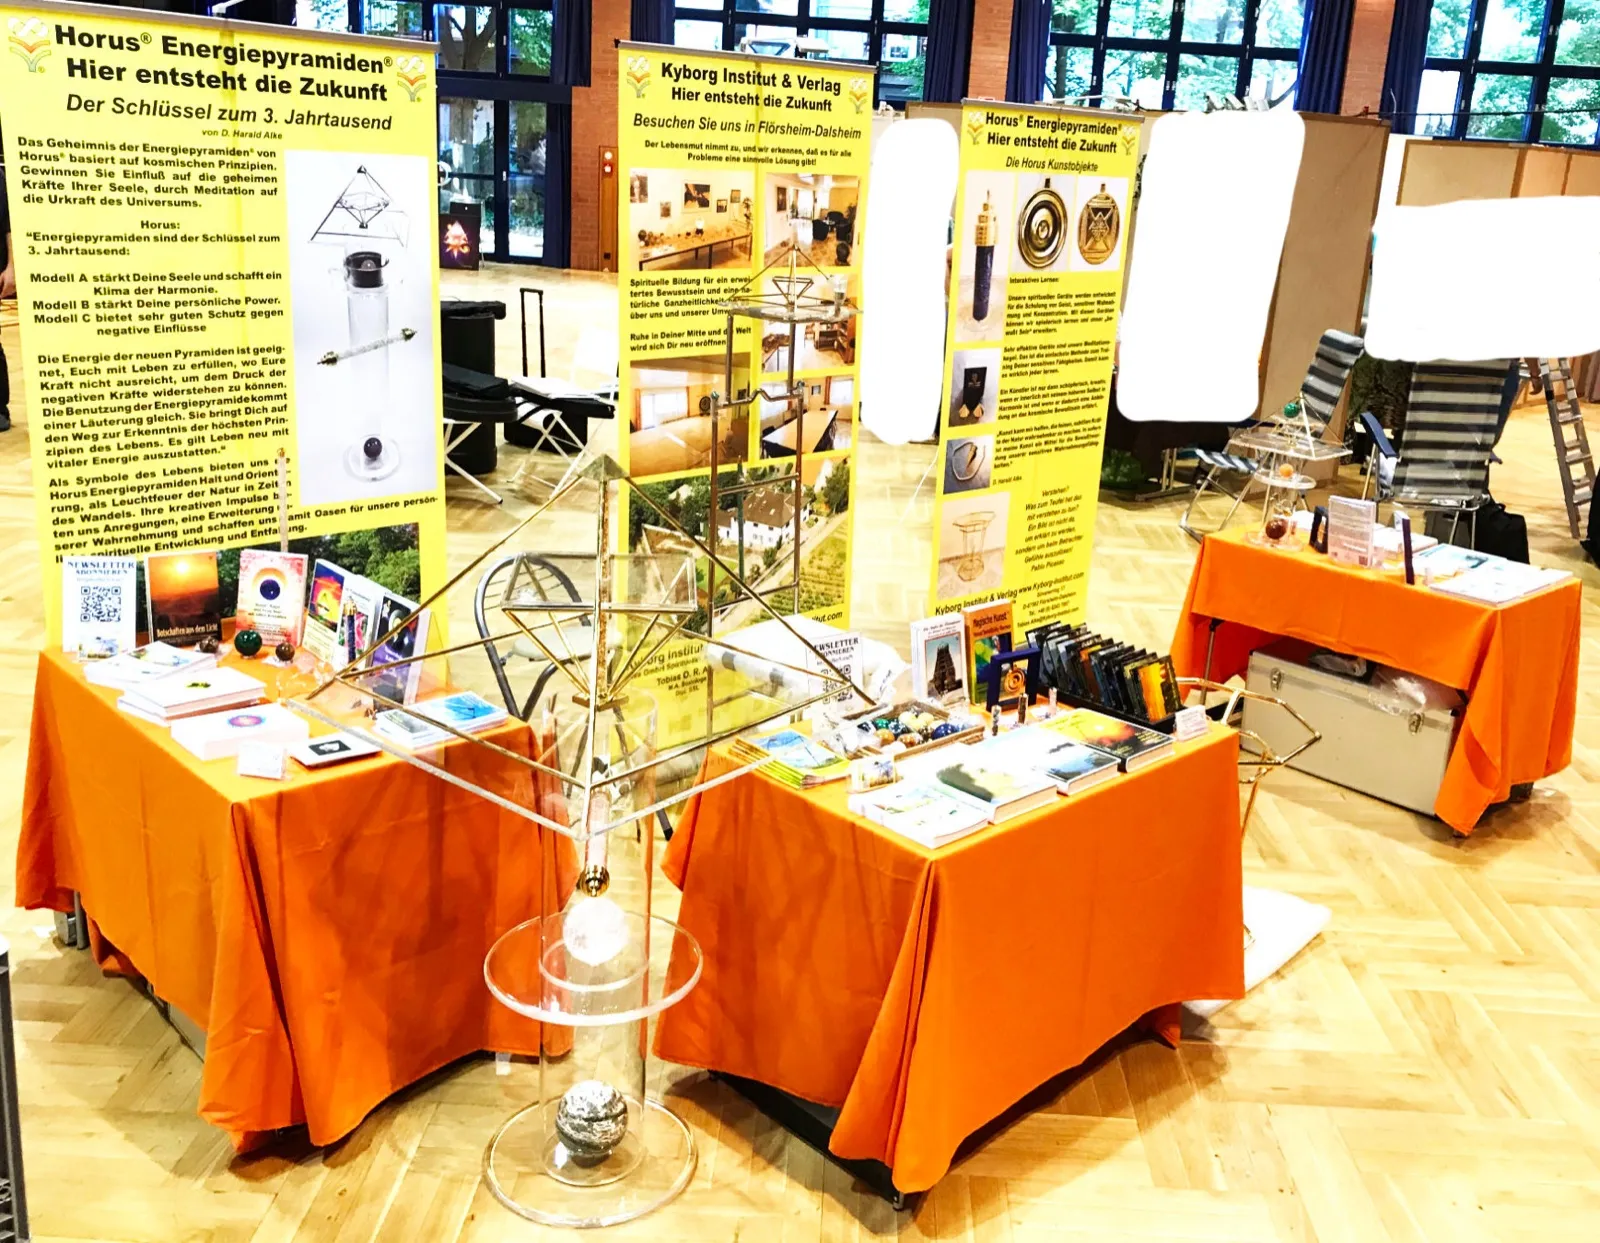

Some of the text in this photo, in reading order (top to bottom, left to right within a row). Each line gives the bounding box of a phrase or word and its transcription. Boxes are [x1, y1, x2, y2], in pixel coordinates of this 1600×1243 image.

[67, 58, 387, 102] Hier entsteht die Zukunft
[661, 62, 841, 97] Kyborg Institut & Verlag
[671, 87, 832, 112] Hier entsteht die Zukunft
[67, 94, 392, 130] Der Schlüssel zum 3. Jahrtausend
[633, 113, 862, 139] Besuchen Sie uns in Flörsheim-Dalsheim
[232, 129, 262, 139] Harald
[264, 131, 283, 140] Alke
[18, 136, 44, 147] Das
[46, 138, 116, 151] Geheimnis
[119, 142, 139, 152] der
[644, 140, 659, 148] Der
[660, 141, 704, 150] Lebensmut
[705, 143, 729, 151] nimmt
[743, 145, 757, 153] und
[770, 146, 804, 156] erkennen,
[806, 148, 819, 156] daß
[687, 152, 723, 162] Probleme
[775, 157, 800, 167] Lösung
[140, 220, 180, 229] Horus:
[153, 234, 178, 242] sind
[180, 234, 199, 242] der
[202, 234, 256, 243] Schlüssel
[29, 246, 130, 256] 3. Jahrtausend:
[30, 271, 282, 283] Modell A stärkt Deine Seele und schafft ein
[630, 278, 670, 288] Spirituelle
[672, 277, 701, 286] Bildung
[703, 276, 714, 284] für
[630, 290, 654, 298] tertes
[656, 288, 705, 297] Bewusstsein
[707, 287, 721, 295] und
[630, 300, 660, 309] türliche
[630, 312, 647, 320] über
[665, 310, 680, 318] und
[97, 324, 207, 337] negative Einflüsse
[630, 333, 649, 341] Ruhe
[707, 328, 722, 336] und
[630, 344, 648, 352] wird
[649, 343, 665, 351] sich
[38, 355, 60, 364] Die
[62, 354, 111, 364] Energie
[113, 352, 133, 361] der
[136, 352, 172, 360] neuen
[174, 348, 235, 360] Pyramiden
[237, 346, 251, 355] ist
[47, 458, 88, 469] vitaler
[92, 454, 139, 465] Energie
[55, 541, 87, 551] serer
[92, 530, 178, 546] Wahrnehmung
[182, 525, 203, 535] und
[208, 520, 255, 532] schaffen
[258, 517, 277, 525] uns
[288, 511, 310, 521] amit
[315, 508, 346, 518] Oasen
[350, 505, 364, 513] für
[367, 501, 400, 511] unsere
[157, 626, 185, 638] Botschaften
[186, 626, 195, 634] aus
[195, 624, 205, 633] dem
[813, 637, 859, 651] EWSLETTER
